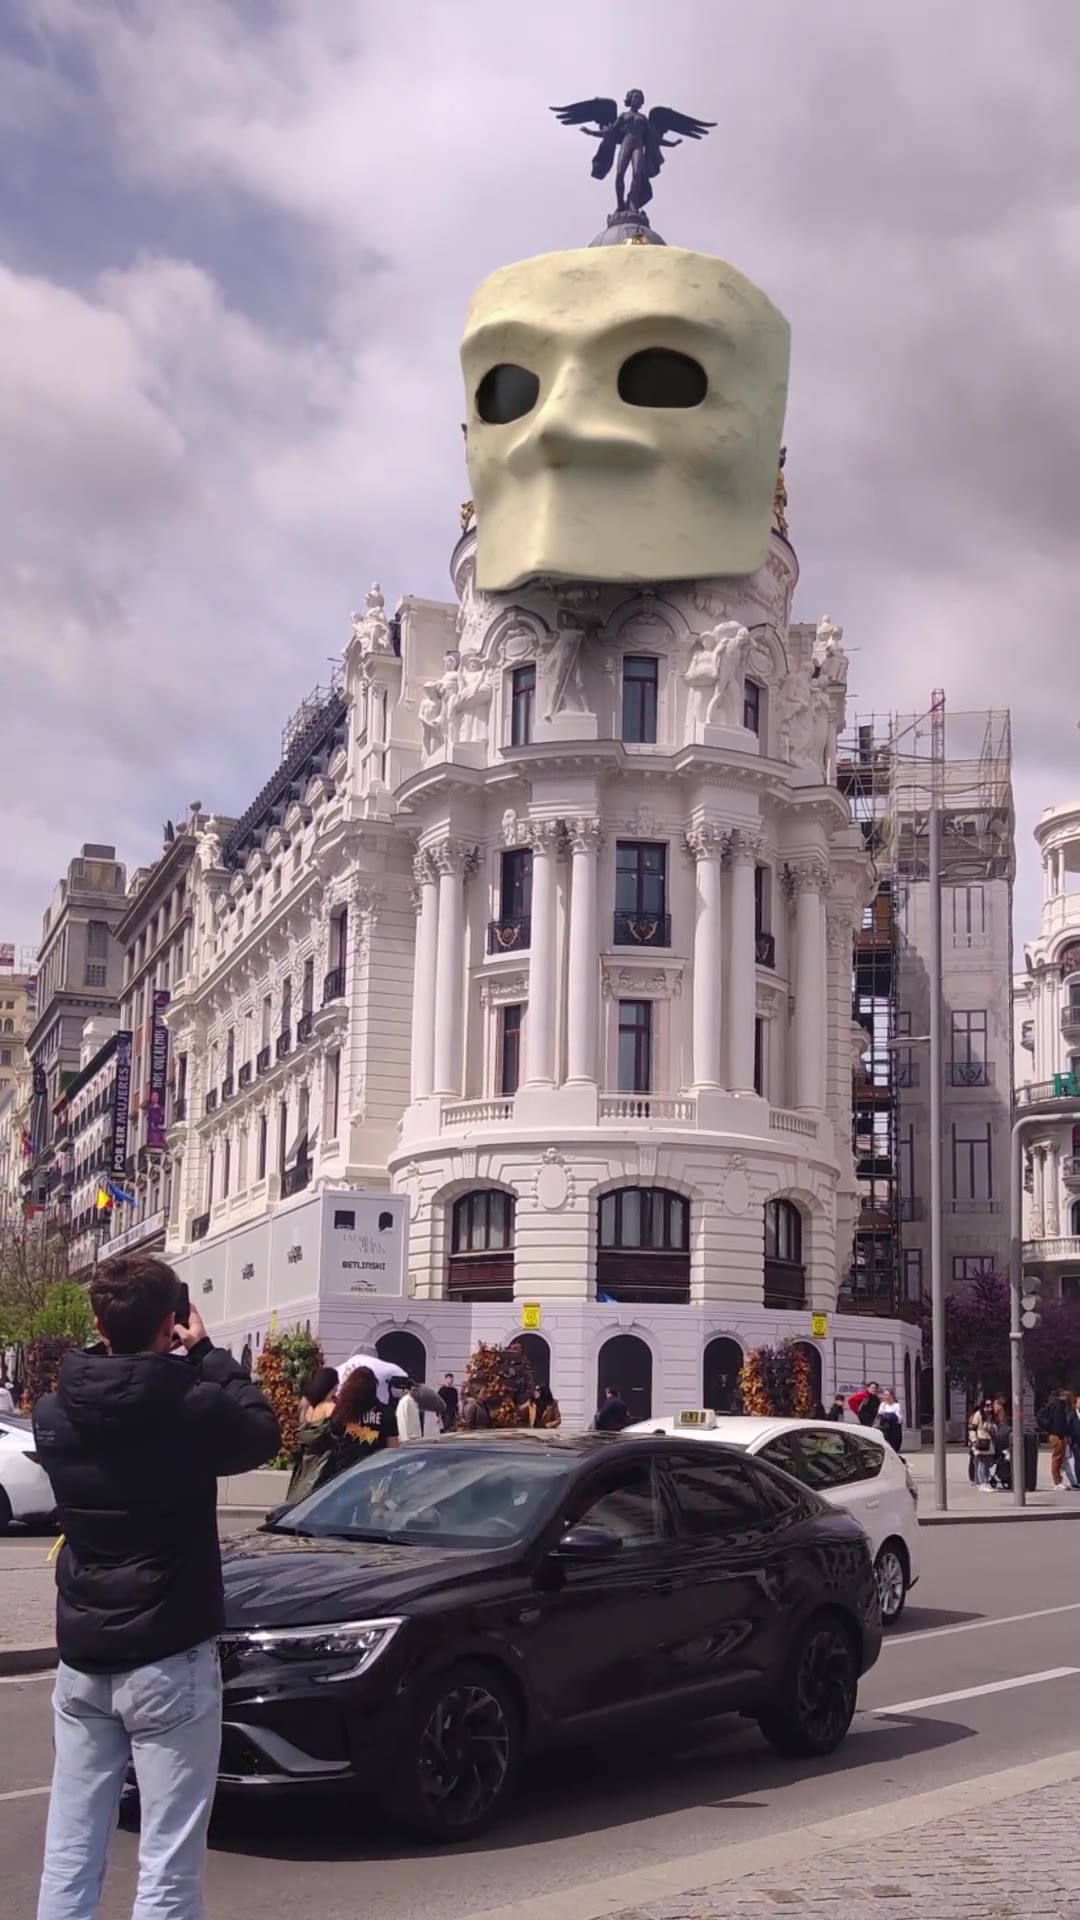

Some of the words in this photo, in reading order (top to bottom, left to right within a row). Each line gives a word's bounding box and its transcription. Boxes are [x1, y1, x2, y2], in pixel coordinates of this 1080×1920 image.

[117, 1067, 129, 1124] MUJERES
[116, 1126, 126, 1145] SER
[114, 1147, 125, 1171] POR
[358, 1411, 383, 1425] URE
